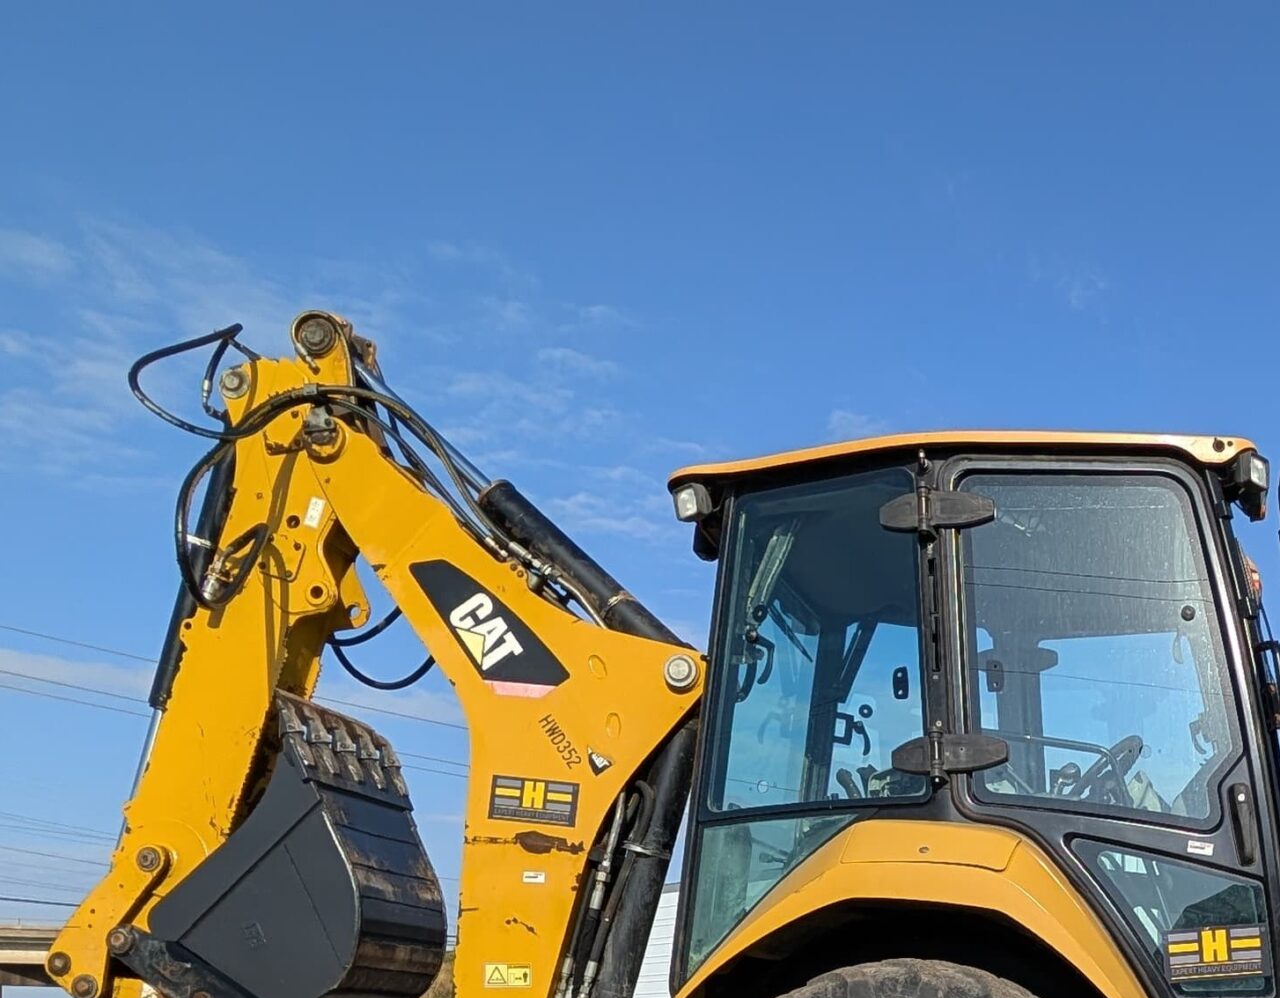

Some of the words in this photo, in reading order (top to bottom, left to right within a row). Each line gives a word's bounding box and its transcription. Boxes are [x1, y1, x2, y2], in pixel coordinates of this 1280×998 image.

[450, 592, 524, 671] CAT
[538, 713, 582, 770] HWD352
[522, 781, 545, 809] H
[1201, 929, 1228, 962] H
